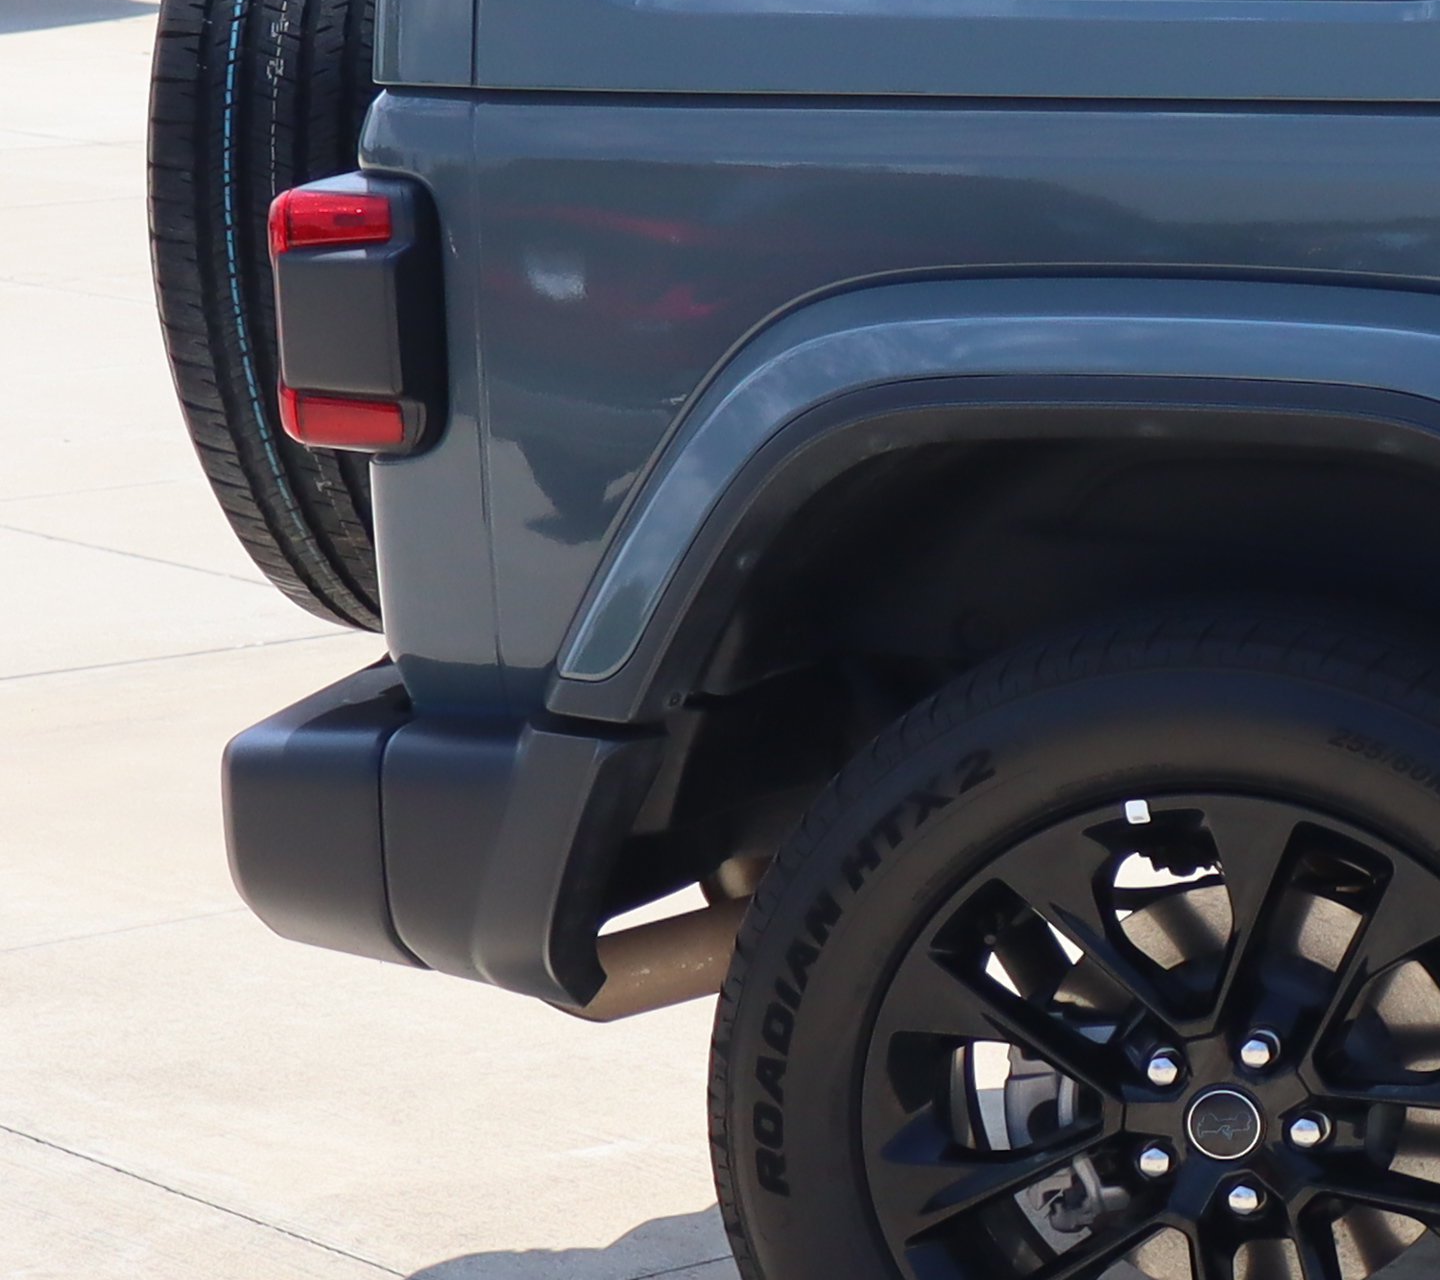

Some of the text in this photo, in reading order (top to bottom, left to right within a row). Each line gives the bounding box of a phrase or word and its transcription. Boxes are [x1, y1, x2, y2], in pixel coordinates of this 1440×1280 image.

[752, 747, 998, 1199] ROADIAN HTX 2
